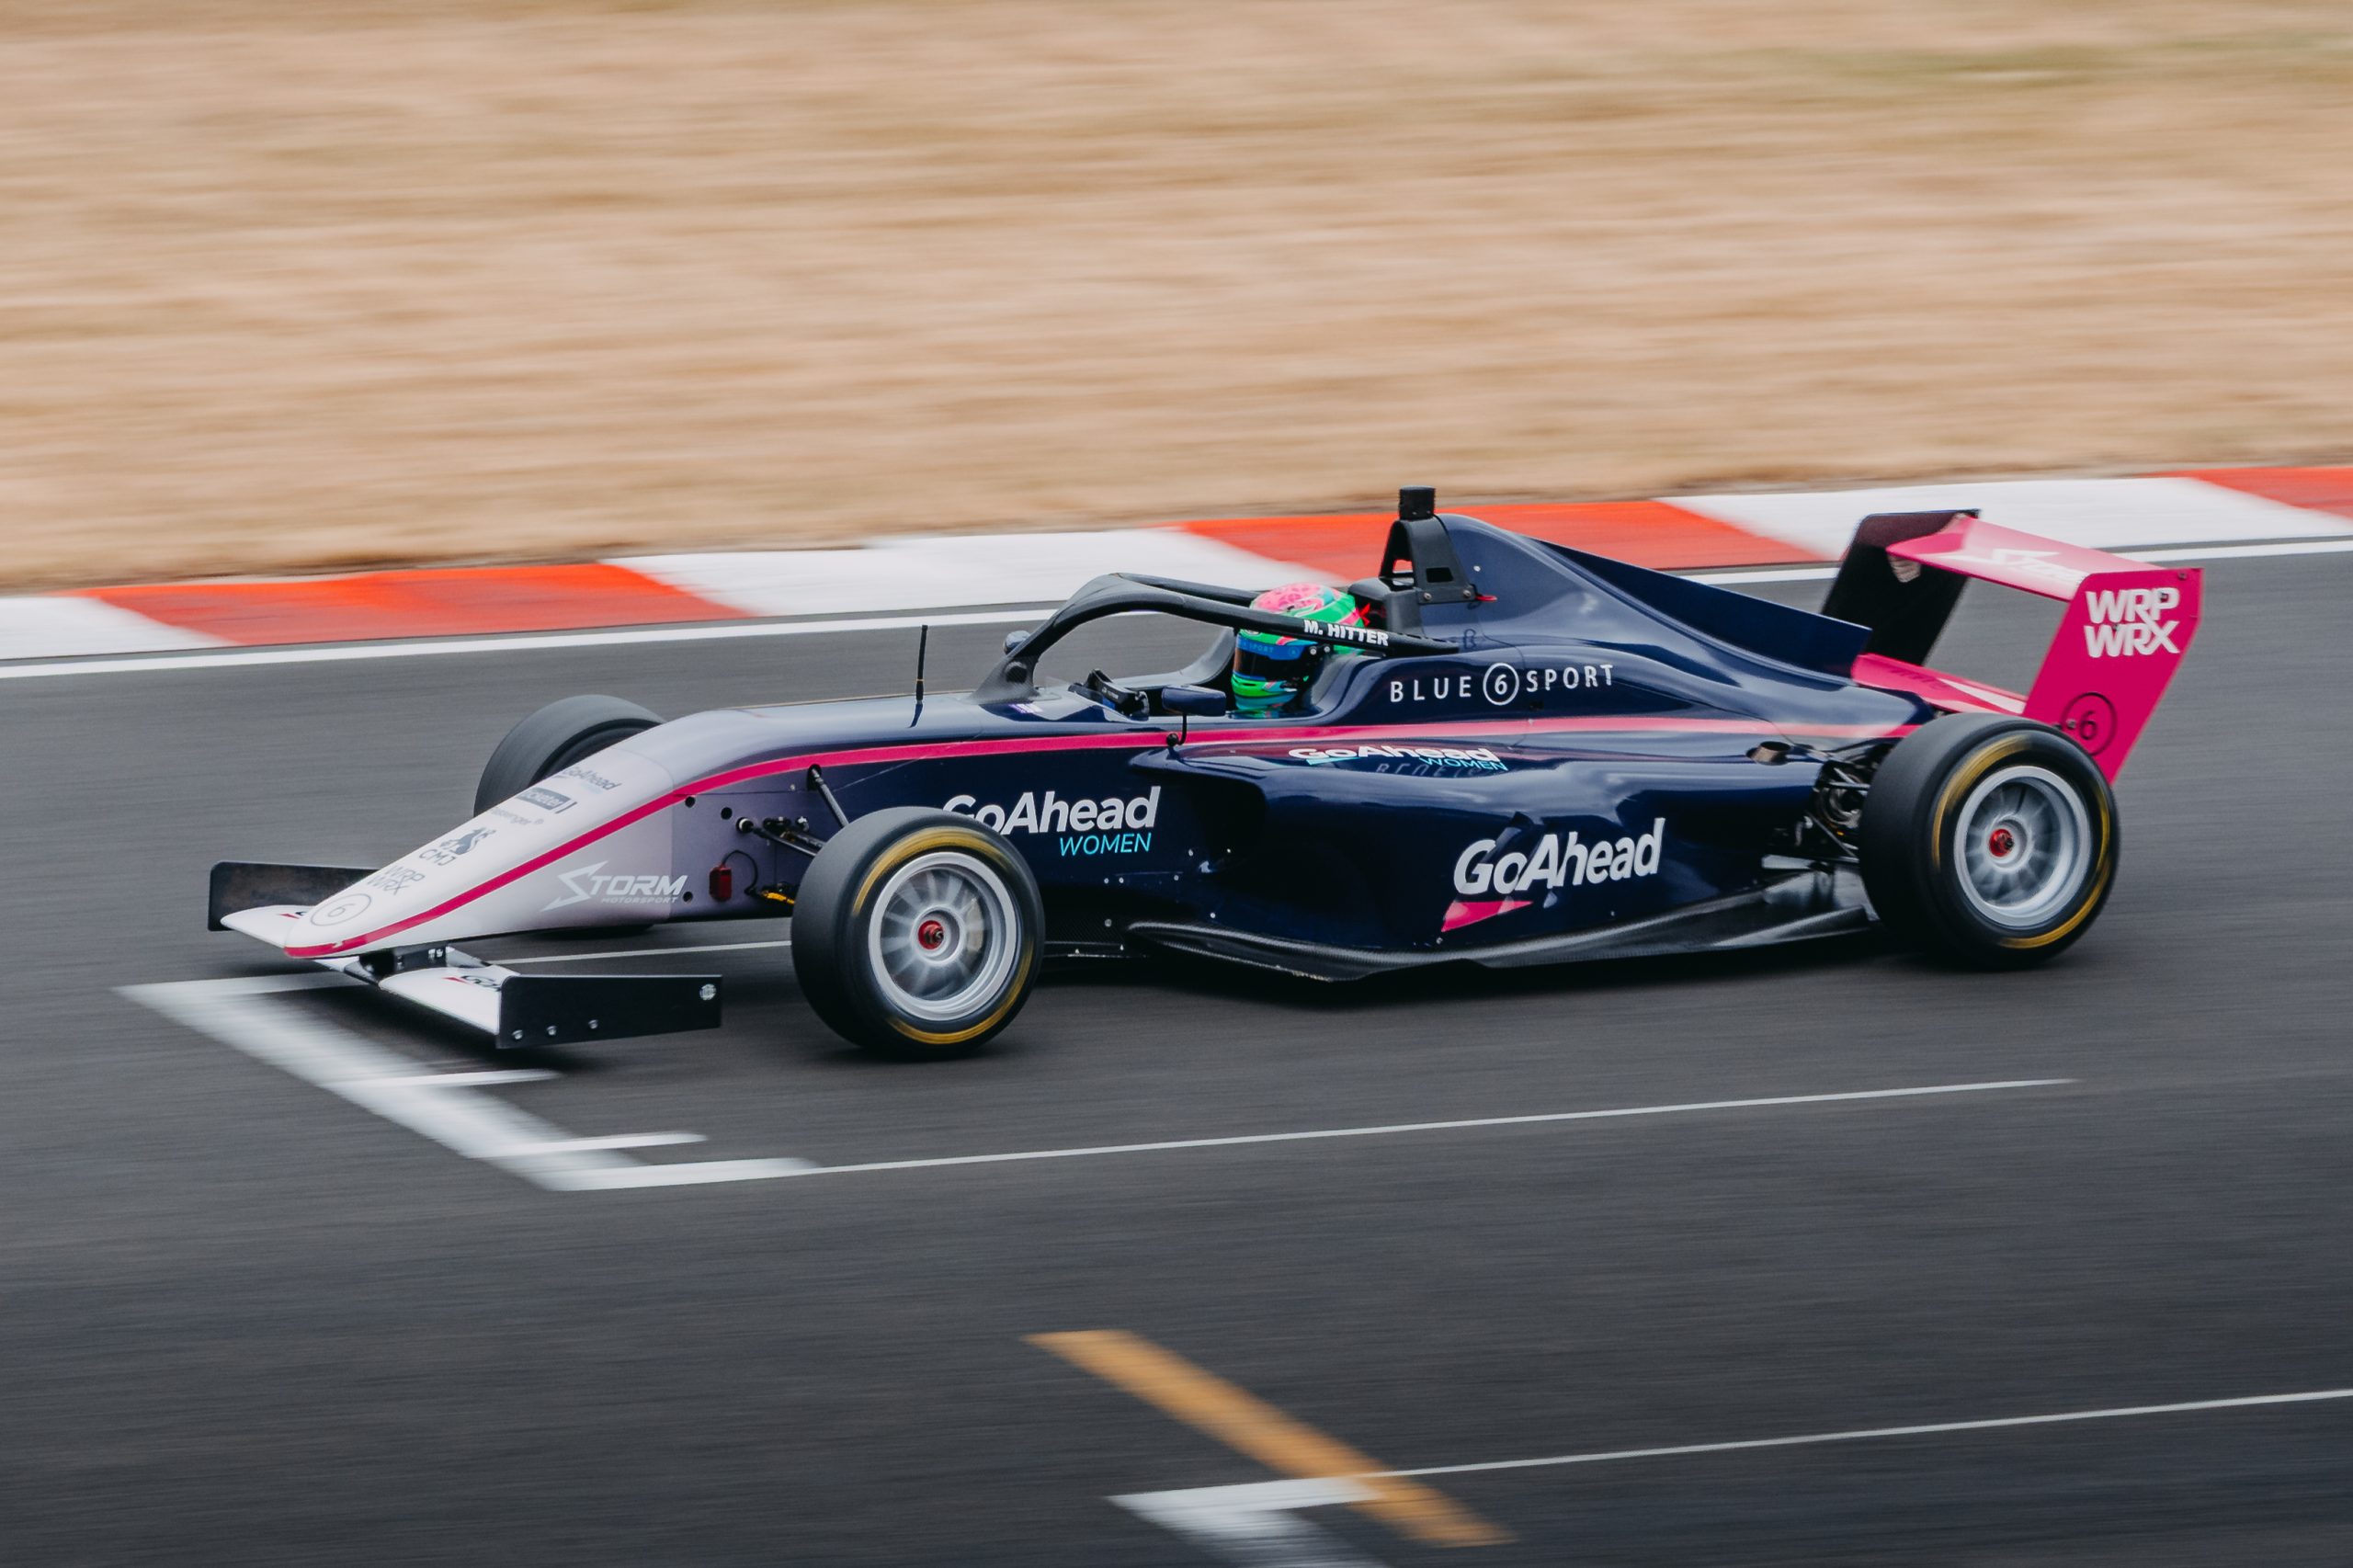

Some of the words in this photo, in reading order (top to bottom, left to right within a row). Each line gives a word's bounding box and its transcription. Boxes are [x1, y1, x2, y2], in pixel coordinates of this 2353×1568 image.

[2085, 587, 2180, 624] WRP
[1303, 619, 1324, 636] M.
[1327, 623, 1389, 647] HITTER
[2083, 620, 2180, 658] WRX
[1390, 676, 1472, 703] BLUE
[1526, 664, 1614, 691] SPORT
[2078, 710, 2099, 741] 6
[1289, 745, 1501, 763] GoAhead
[1418, 756, 1509, 771] WOMEN
[418, 848, 457, 867] CMJ
[1059, 832, 1153, 857] WOMEN
[1453, 817, 1666, 895] GoAhead
[540, 860, 689, 913] STORM
[600, 896, 681, 904] MOTORSPORT
[327, 903, 356, 918] 6
